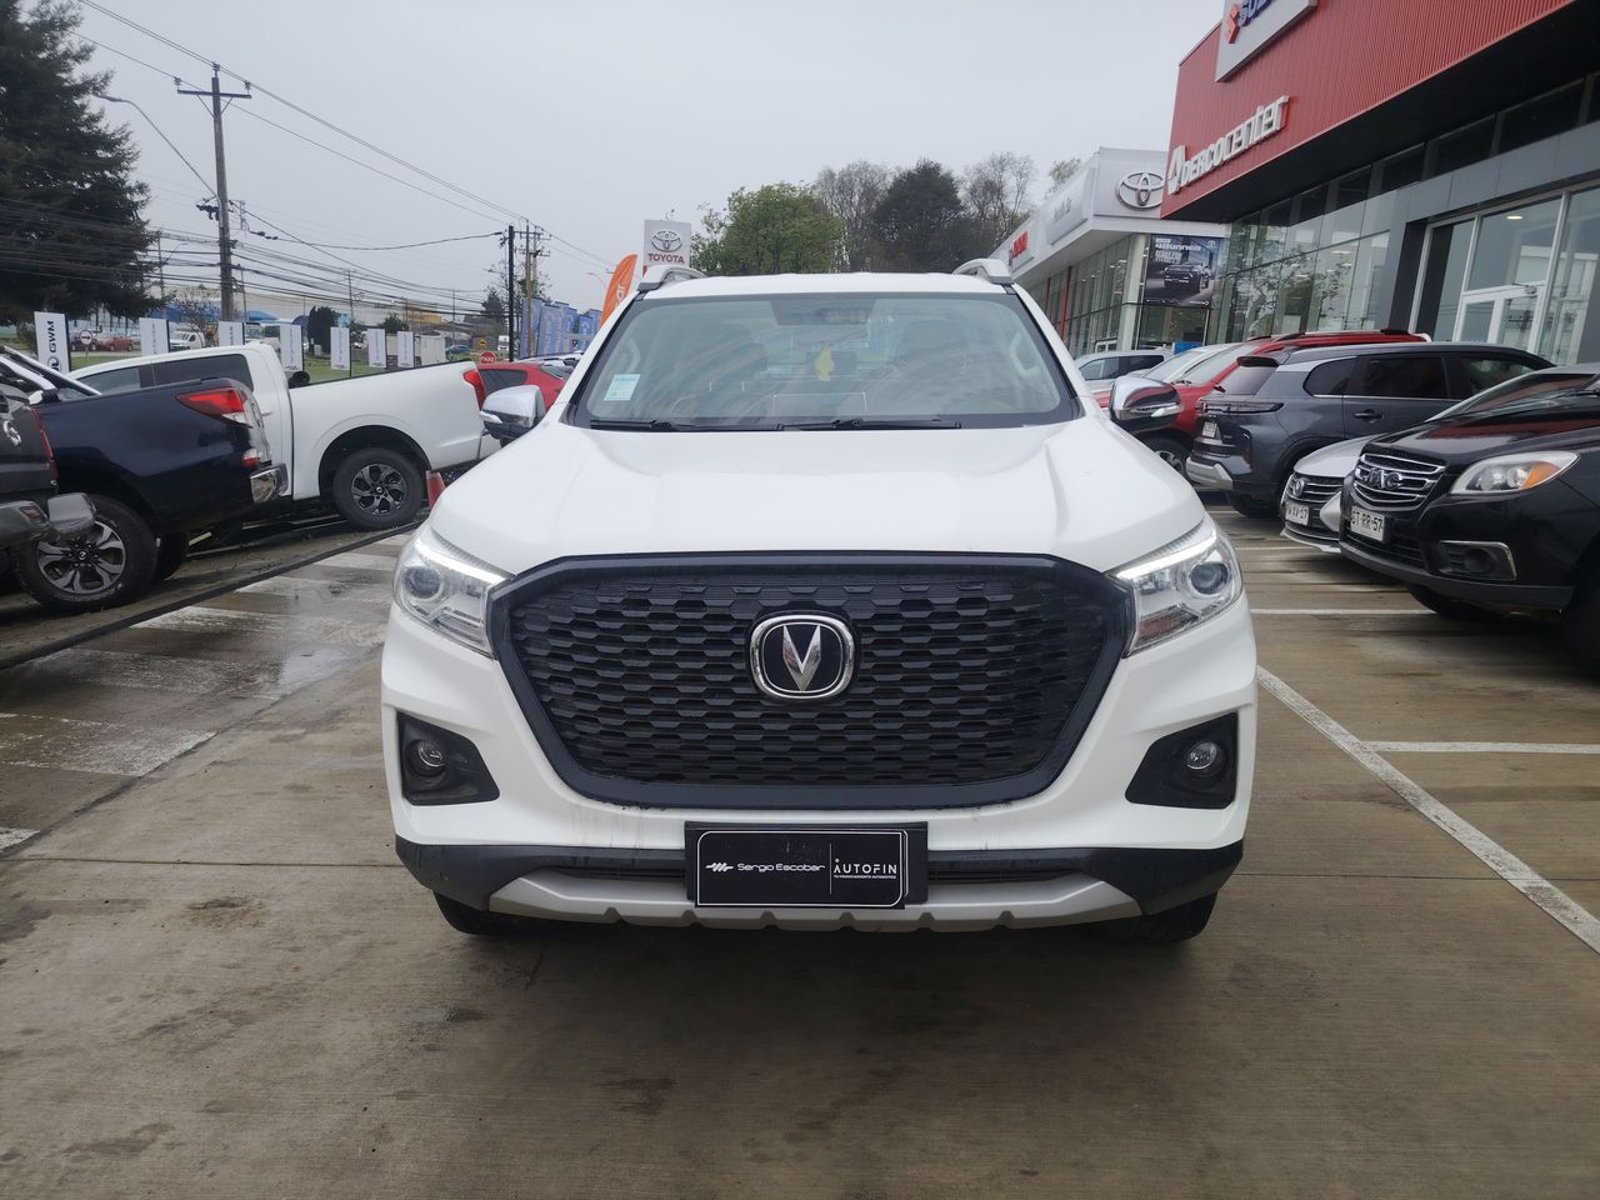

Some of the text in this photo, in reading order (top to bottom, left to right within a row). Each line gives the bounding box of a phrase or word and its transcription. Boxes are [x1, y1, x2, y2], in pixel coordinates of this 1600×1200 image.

[648, 253, 685, 264] TOYOTA
[47, 320, 57, 353] GWM
[776, 863, 826, 871] Escobar
[833, 858, 897, 874] AUTOFIN
